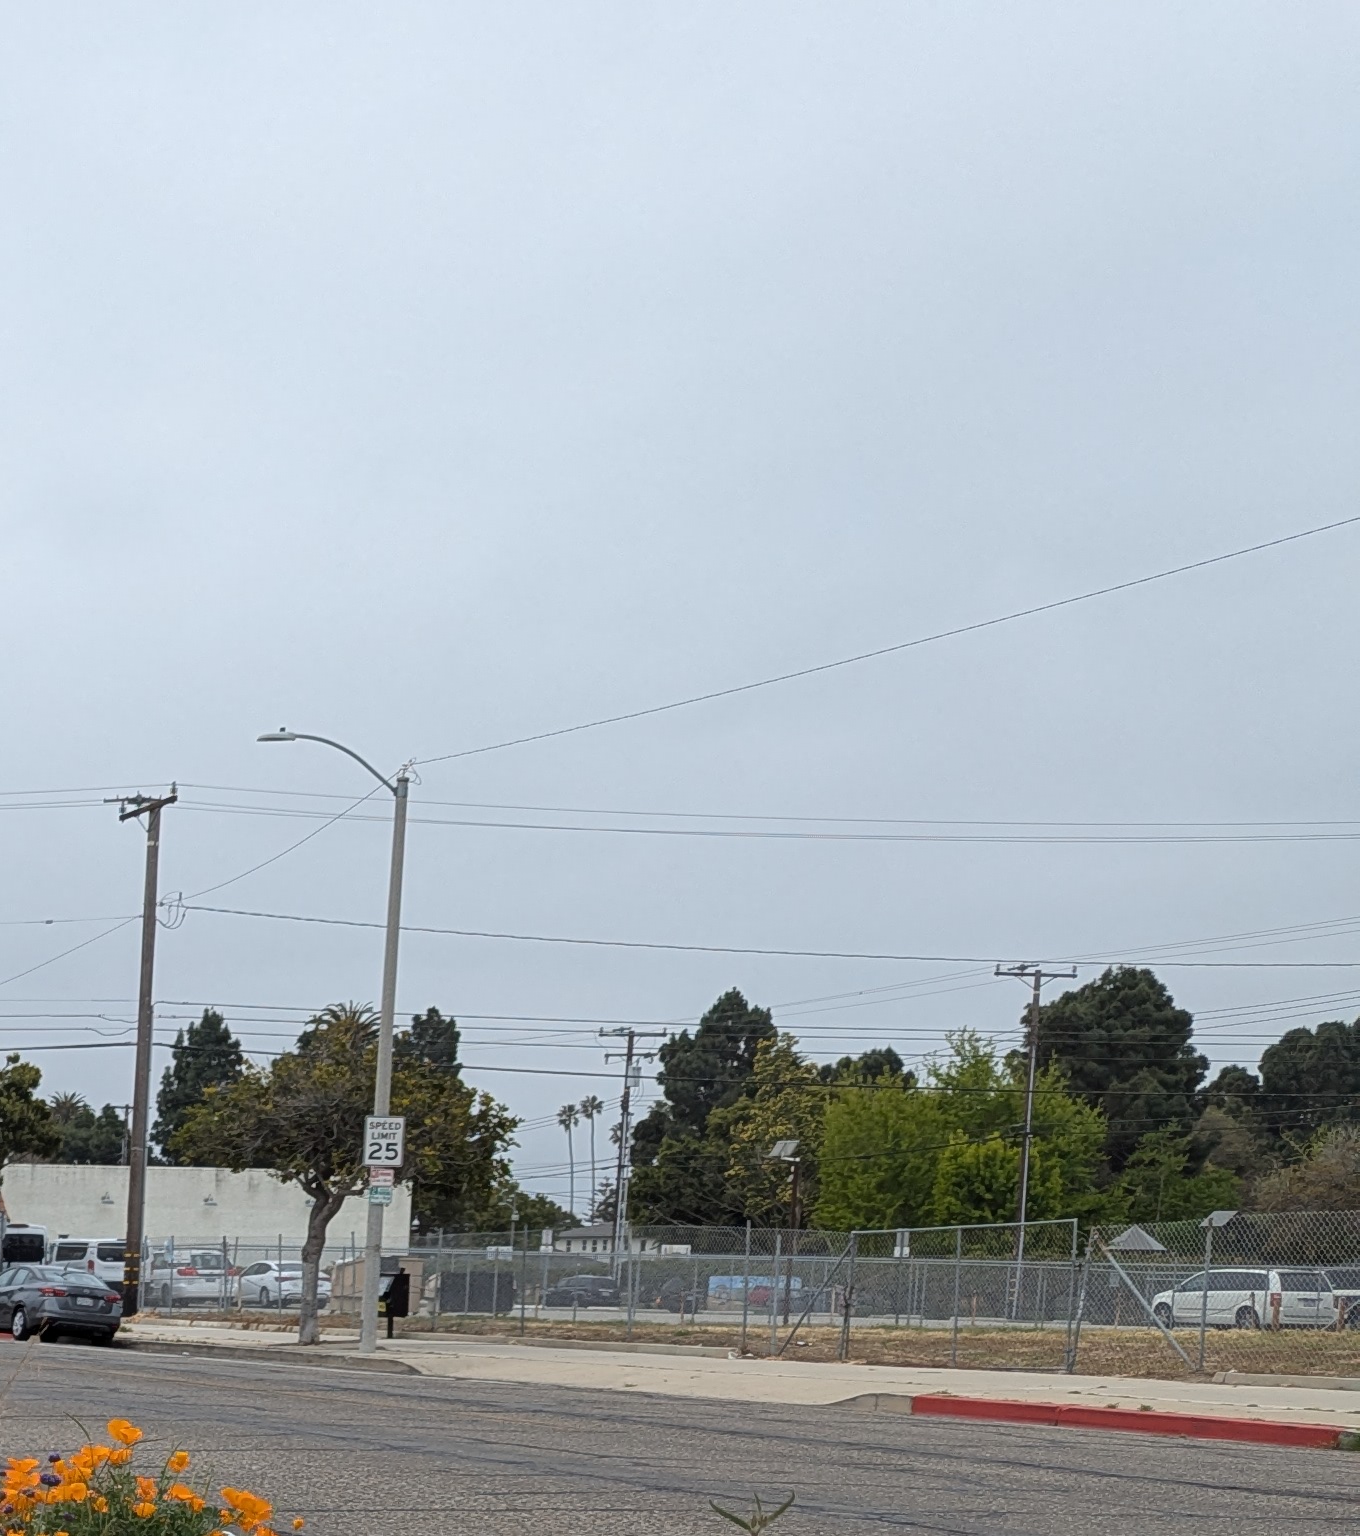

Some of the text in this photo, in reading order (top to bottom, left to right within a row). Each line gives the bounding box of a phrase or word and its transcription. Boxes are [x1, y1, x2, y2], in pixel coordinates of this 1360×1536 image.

[369, 1121, 402, 1131] SPEED
[371, 1132, 398, 1140] LIMIT
[368, 1142, 399, 1161] 25
